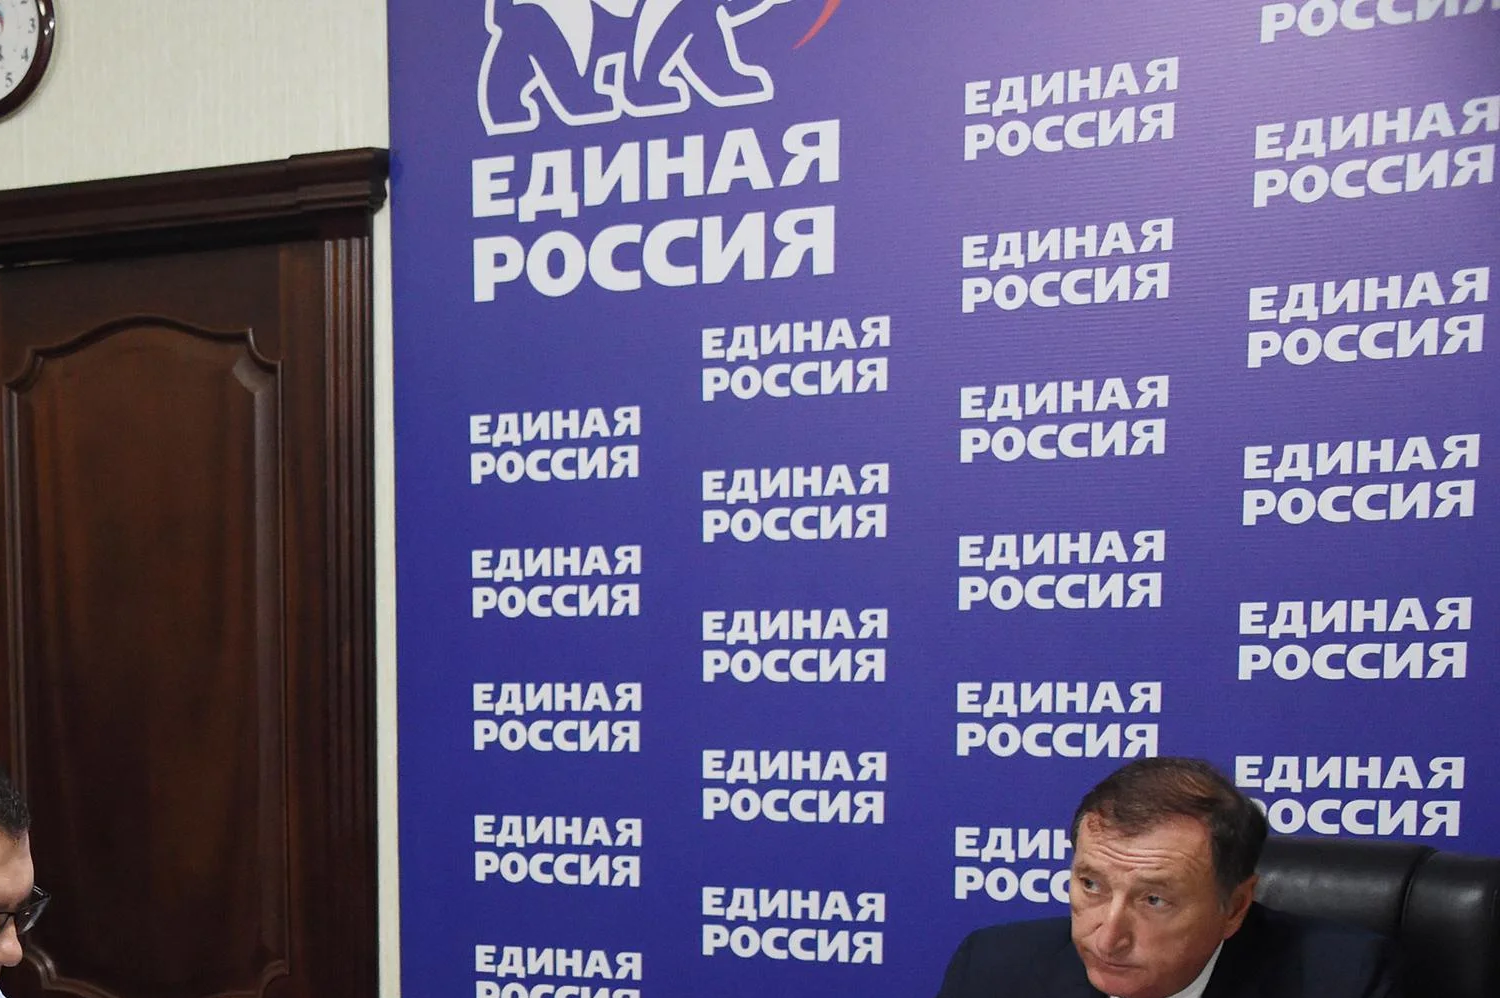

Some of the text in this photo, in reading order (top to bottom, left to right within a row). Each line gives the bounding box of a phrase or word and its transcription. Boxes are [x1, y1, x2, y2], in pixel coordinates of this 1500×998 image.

[5, 72, 13, 88] 5
[965, 57, 1179, 116] ЕДИНАЯ
[965, 102, 1174, 160] РОССИЯ
[1255, 96, 1500, 161] ЕДИНАЯ
[472, 119, 841, 222] ЕДИНАЯ
[1254, 144, 1495, 207] РОССИЯ
[474, 206, 836, 302] РОССИЯ
[963, 218, 1174, 270] ЕДИНАЯ
[962, 262, 1170, 313] РОССИЯ
[1249, 267, 1490, 323] ЕДИНАЯ
[702, 315, 891, 361] ЕДИНАЯ
[1248, 314, 1485, 368] РОССИЯ
[702, 357, 889, 401] РОССИЯ
[961, 375, 1170, 422] ЕДИНАЯ
[470, 406, 641, 447] ЕДИНАЯ
[960, 418, 1166, 463] РОССИЯ
[470, 445, 640, 484] РОССИЯ
[1243, 433, 1481, 482] ЕДИНАЯ
[702, 463, 890, 504] ЕДИНАЯ
[1242, 480, 1476, 526] РОССИЯ
[702, 503, 888, 543] РОССИЯ
[471, 545, 642, 582] ЕДИНАЯ
[958, 529, 1166, 571] ЕДИНАЯ
[472, 583, 640, 618] РОССИЯ
[958, 572, 1162, 611] РОССИЯ
[702, 608, 888, 645] ЕДИНАЯ
[1239, 597, 1473, 638] ЕДИНАЯ
[702, 648, 886, 682] РОССИЯ
[1237, 641, 1468, 680] РОССИЯ
[473, 682, 642, 715] ЕДИНАЯ
[956, 681, 1162, 718] ЕДИНАЯ
[474, 719, 641, 752] РОССИЯ
[956, 722, 1159, 758] РОССИЯ
[702, 749, 887, 784] ЕДИНАЯ
[1235, 755, 1465, 793] ЕДИНАЯ
[702, 787, 885, 825] РОССИЯ
[1255, 798, 1460, 837] ОССИЯ
[474, 814, 642, 848] ЕДИНАЯ
[955, 826, 1073, 863] ЕДИН
[474, 850, 641, 887] РОССИЯ
[954, 866, 1072, 904] РОСС
[702, 886, 886, 922] ЕДИНАЯ
[475, 944, 642, 980] ЕДИНАЯ
[702, 924, 883, 964] РОССИЯ
